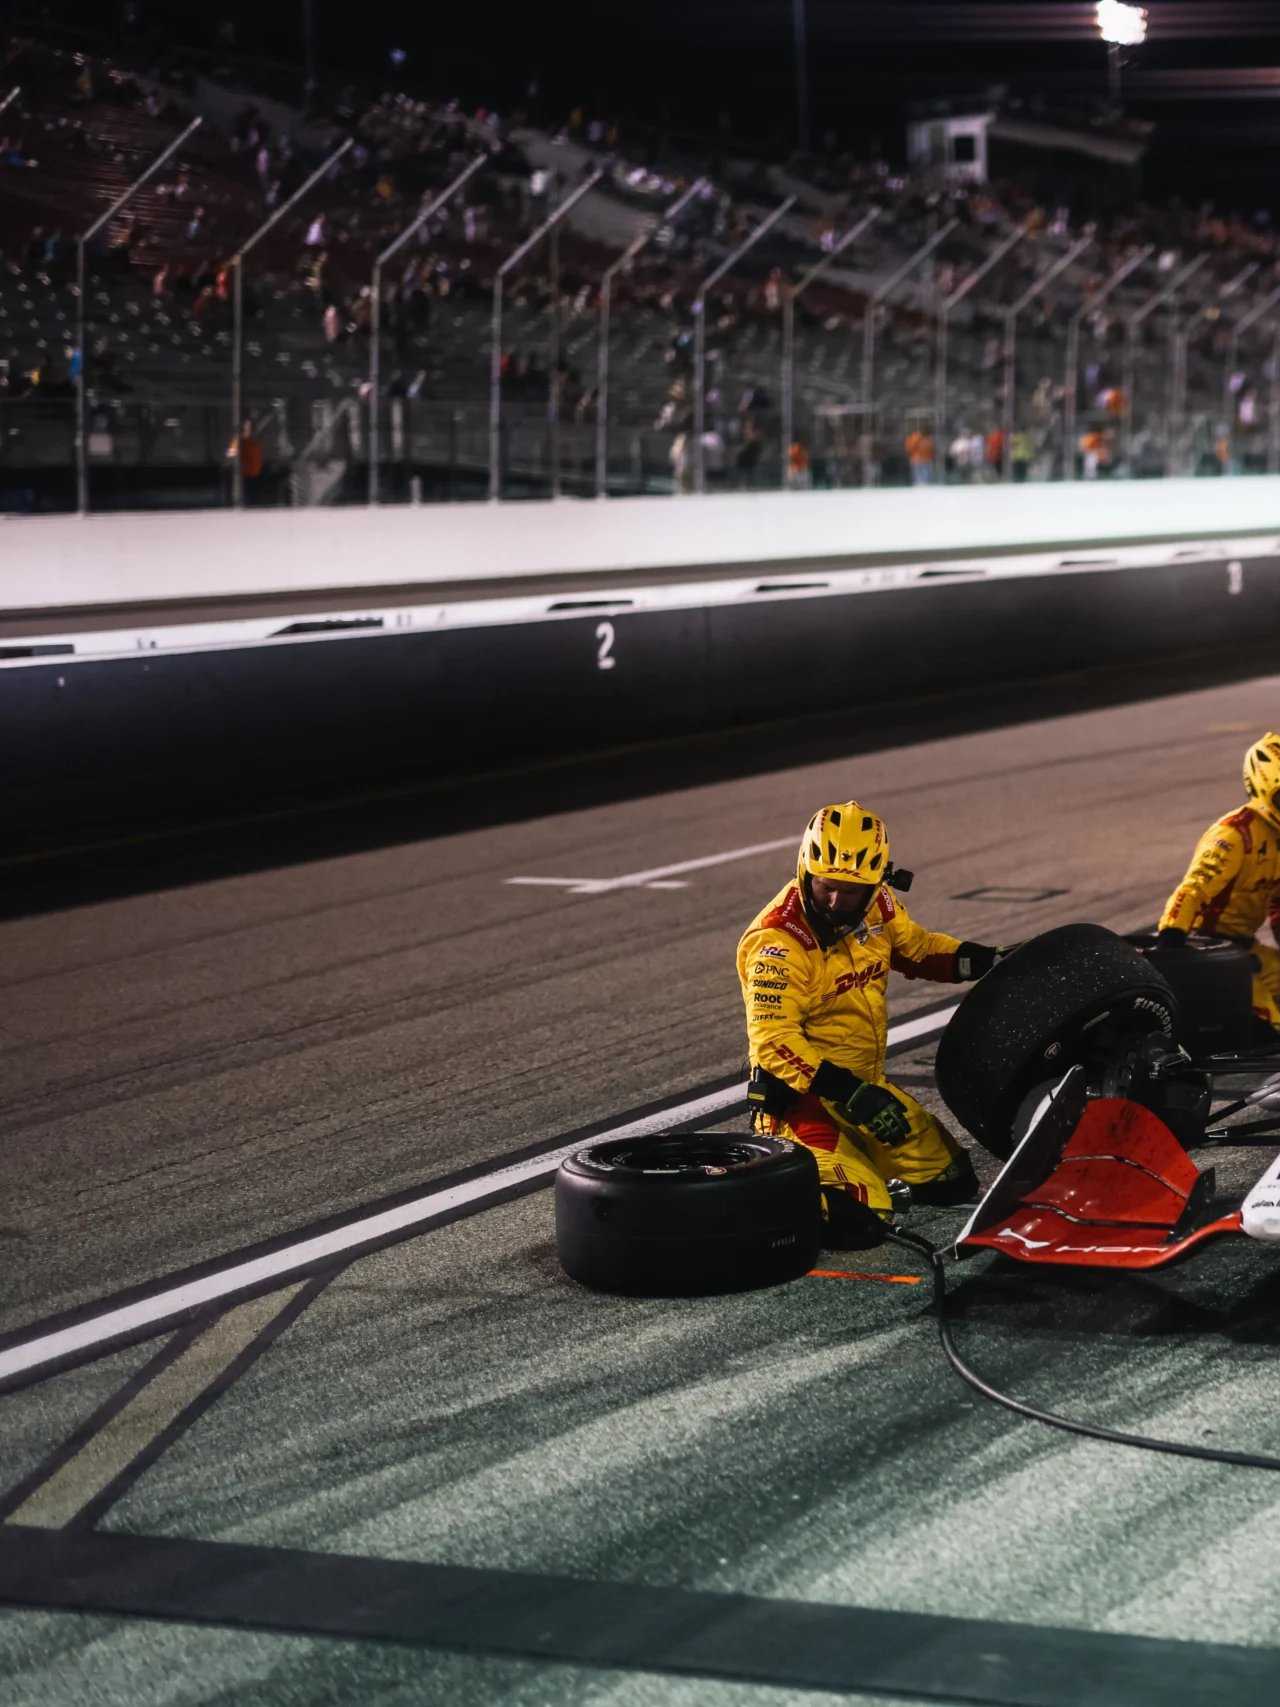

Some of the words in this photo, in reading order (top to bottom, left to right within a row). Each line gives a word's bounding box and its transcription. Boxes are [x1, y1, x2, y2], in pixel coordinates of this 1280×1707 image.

[595, 621, 616, 668] 2
[826, 867, 861, 877] DHL
[785, 921, 813, 946] sparco
[760, 945, 790, 958] HRC
[765, 964, 790, 978] PNC
[833, 960, 886, 996] DHL
[753, 979, 788, 990] SUNOCO
[753, 992, 782, 1004] Root
[752, 1013, 774, 1021] JIFFY
[1132, 997, 1172, 1039] Firestone
[774, 1044, 816, 1079] DHL
